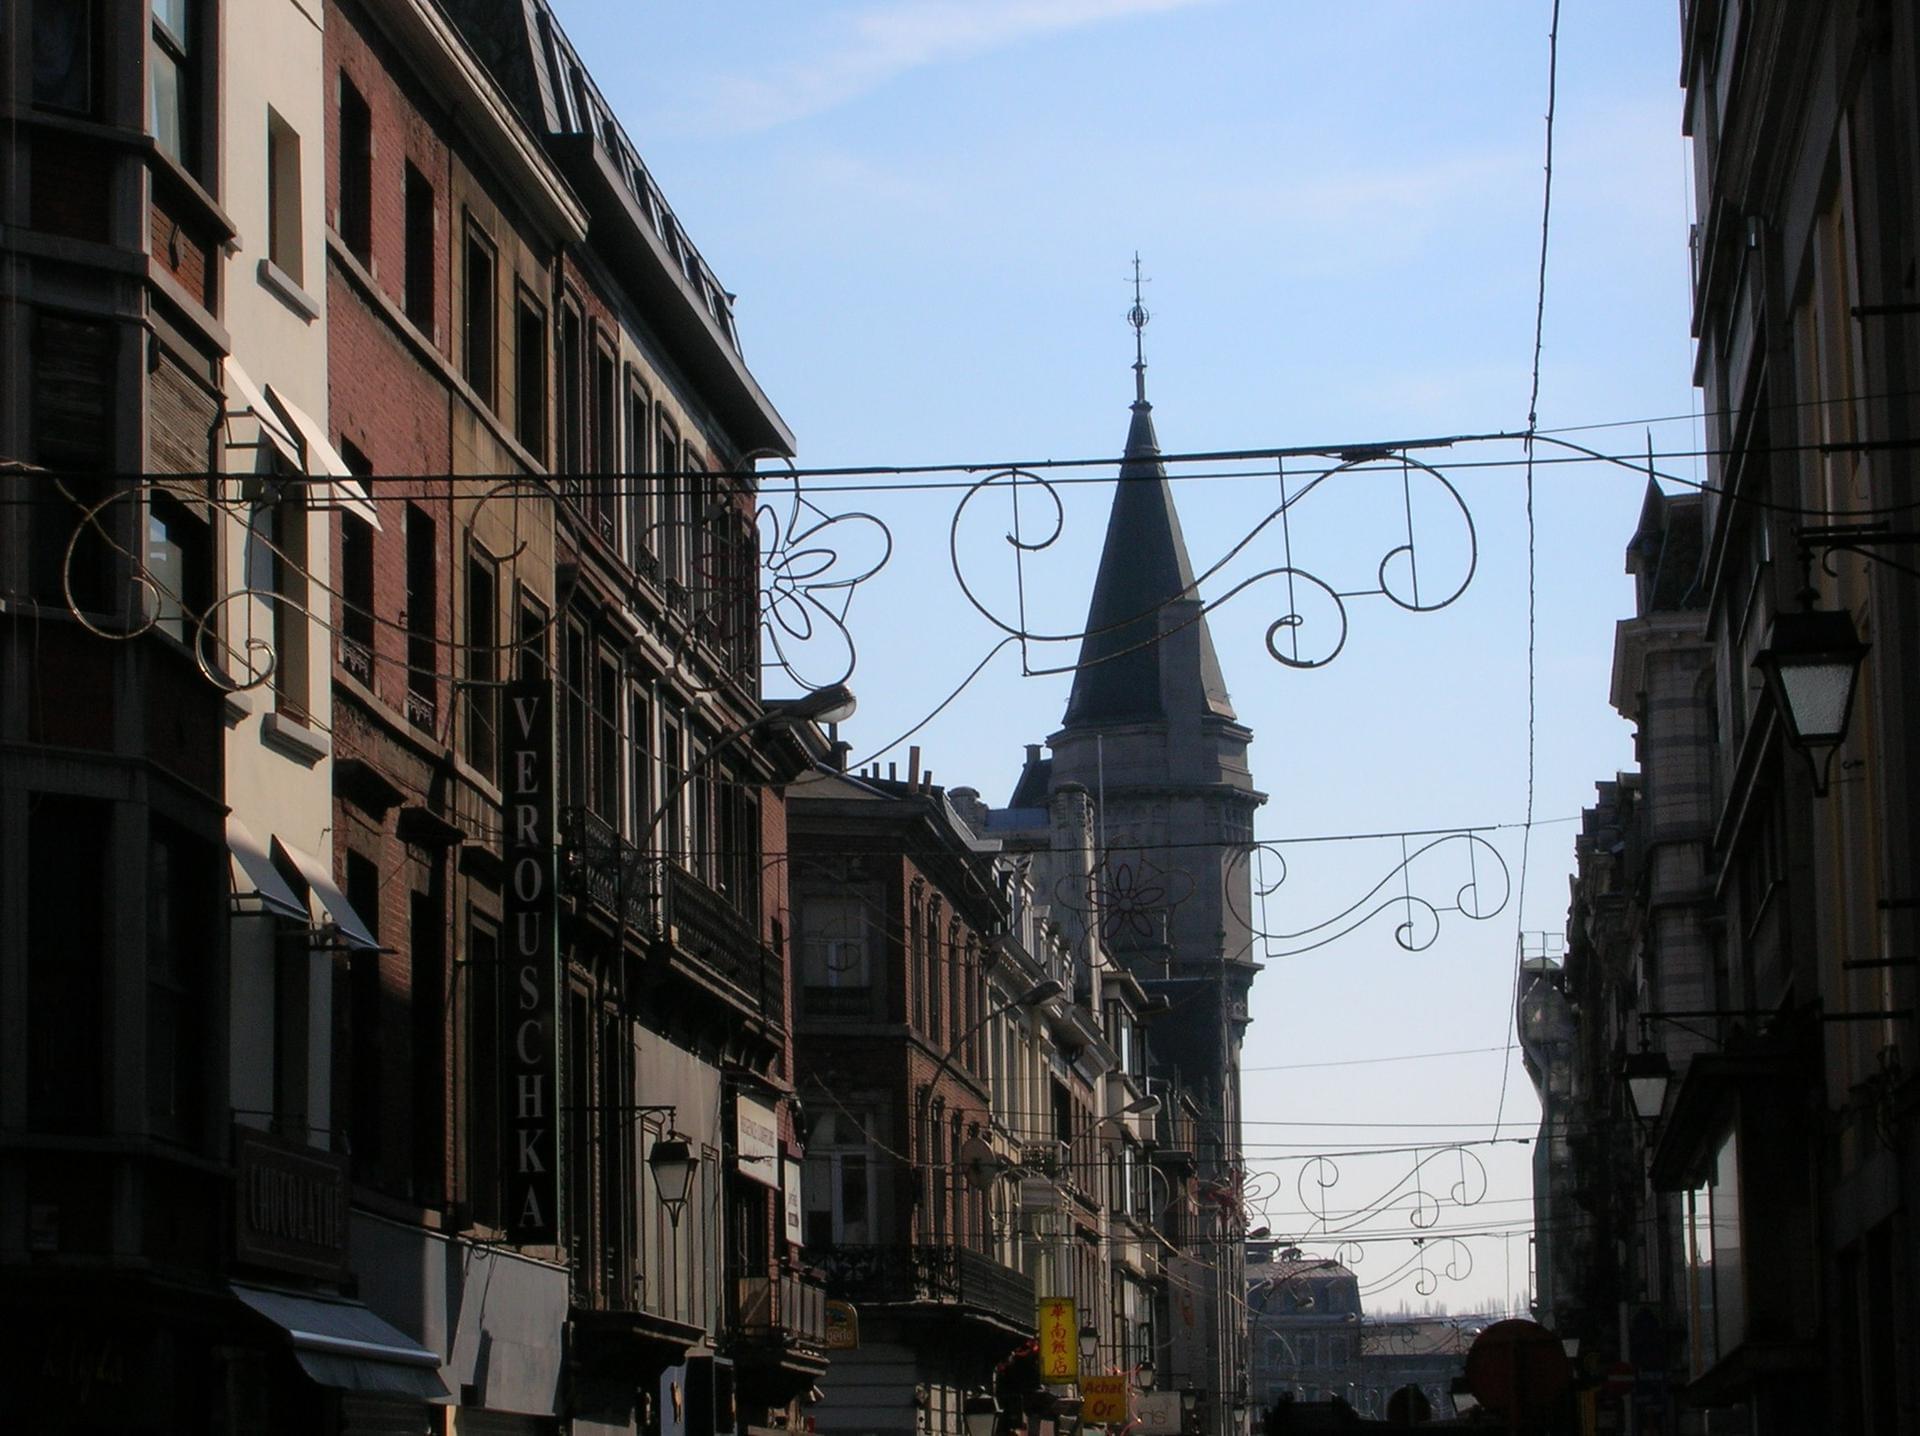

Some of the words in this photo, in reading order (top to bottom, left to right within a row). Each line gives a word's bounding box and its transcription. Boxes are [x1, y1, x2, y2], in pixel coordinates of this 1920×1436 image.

[512, 697, 547, 1228] VEROUSCHKA
[1085, 1381, 1123, 1394] Achat
[1091, 1399, 1117, 1416] Or
